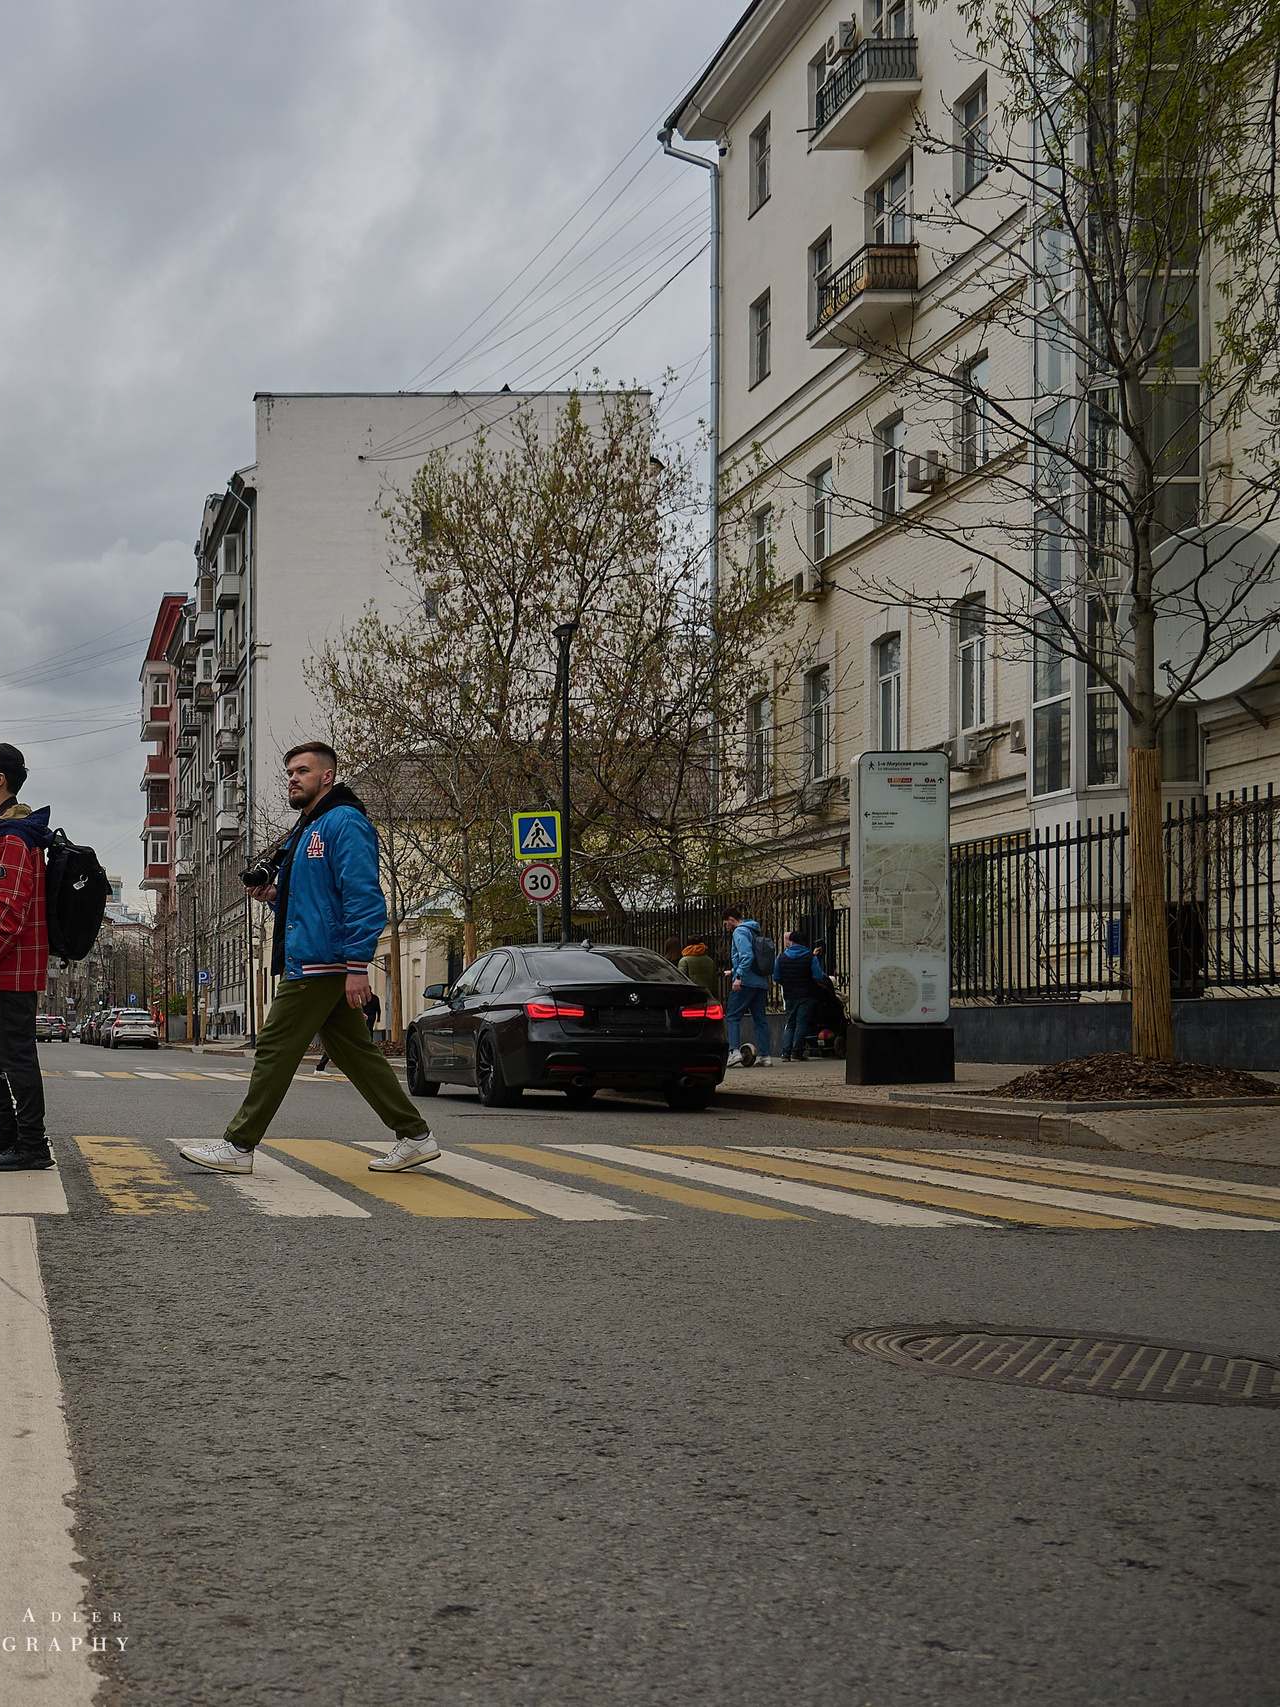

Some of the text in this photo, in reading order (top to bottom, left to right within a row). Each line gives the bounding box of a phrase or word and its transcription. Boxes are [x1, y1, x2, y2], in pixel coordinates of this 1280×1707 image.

[307, 831, 325, 858] LA
[528, 874, 552, 891] 30
[198, 971, 207, 984] P
[129, 994, 137, 1003] P
